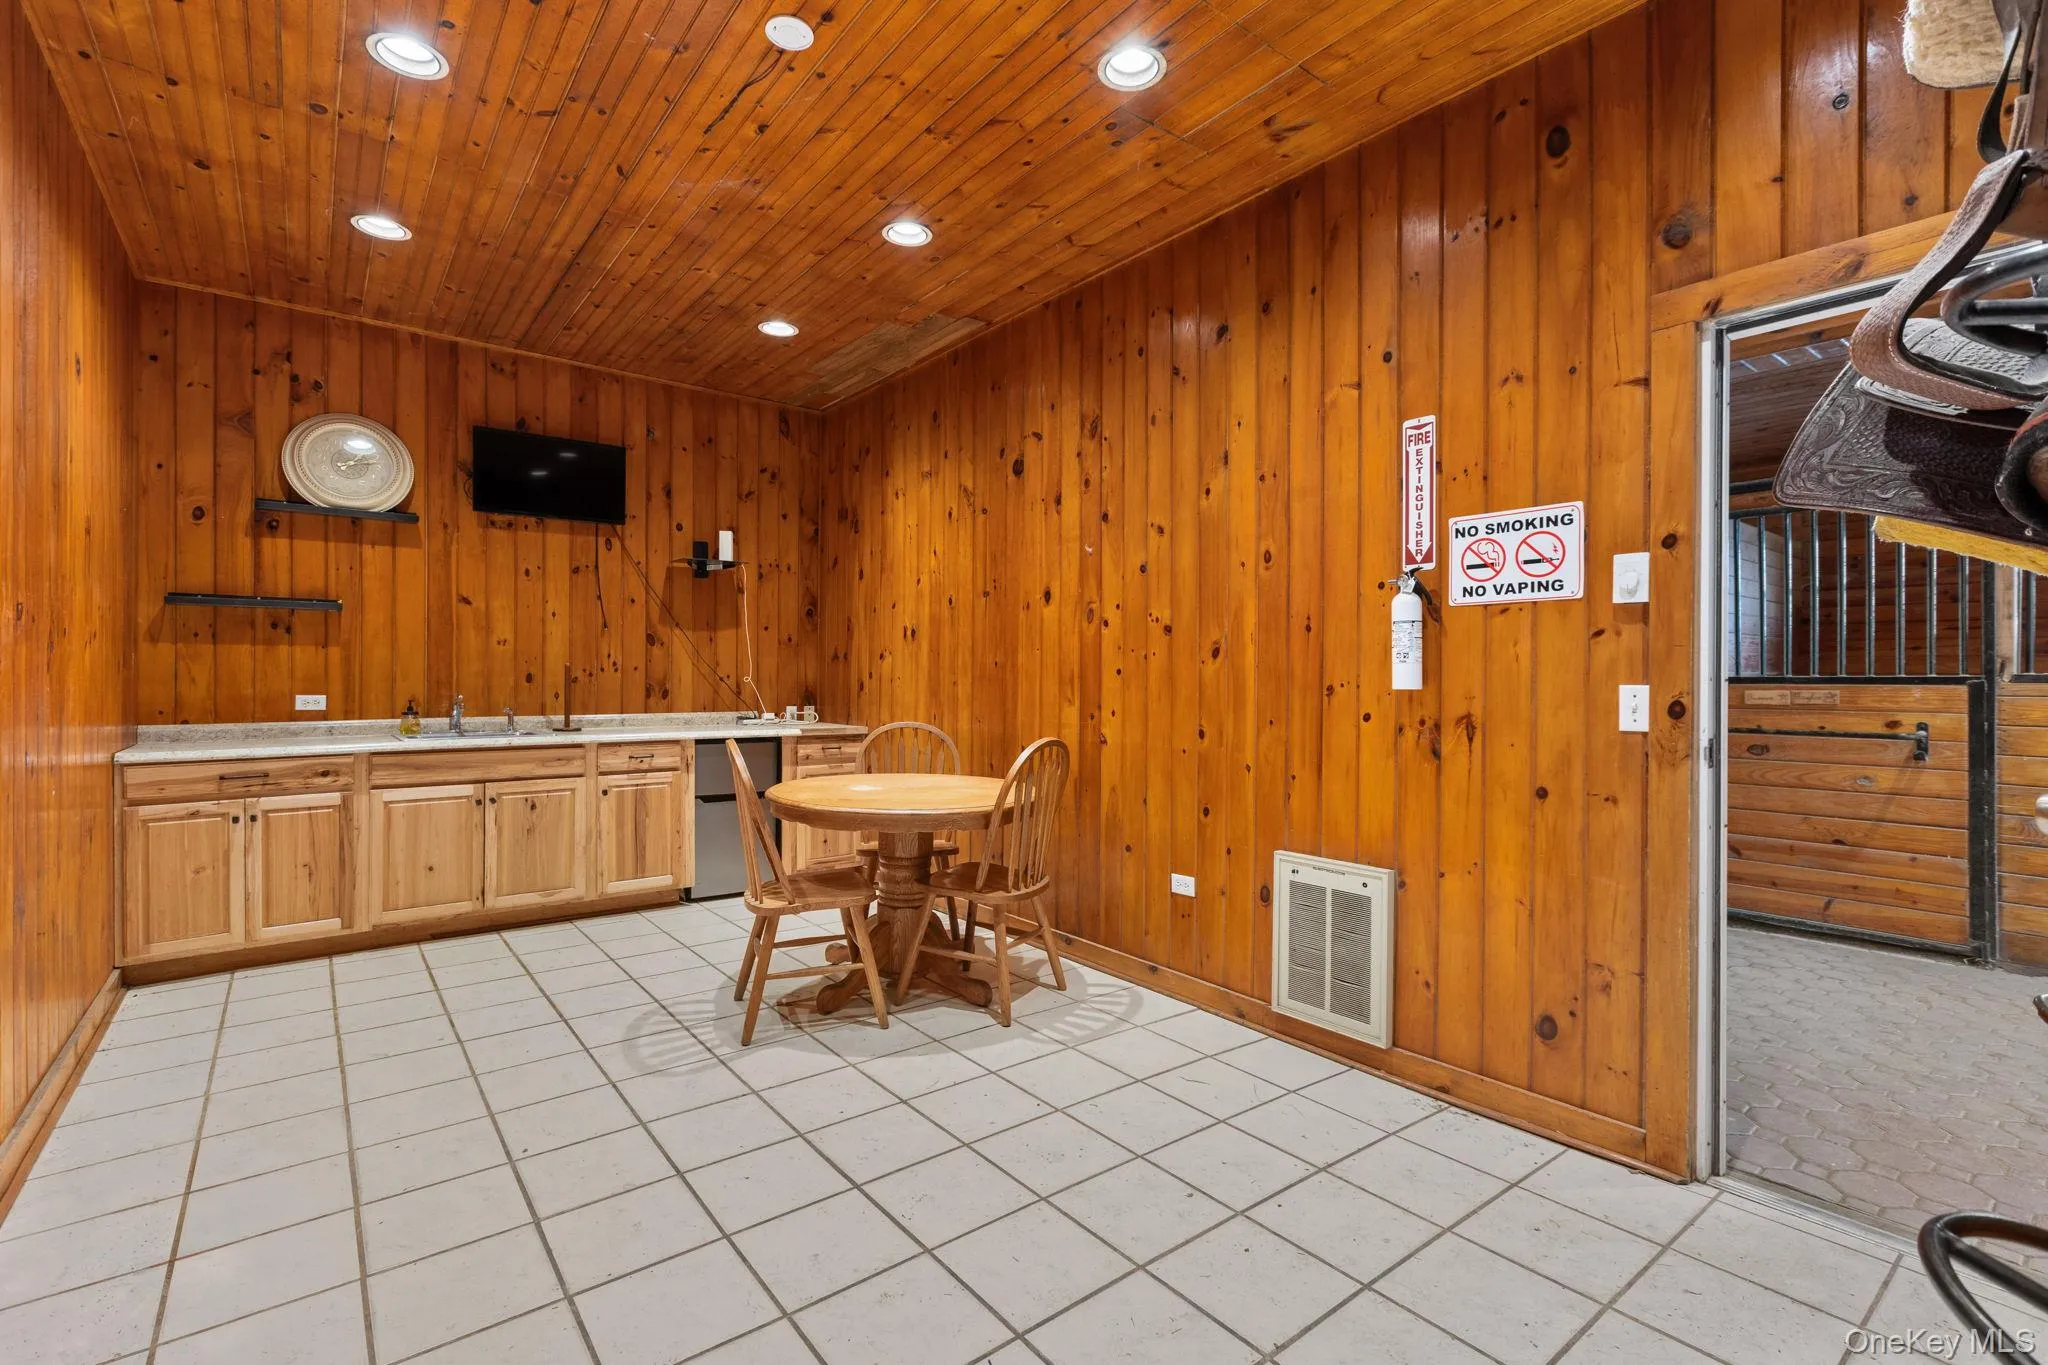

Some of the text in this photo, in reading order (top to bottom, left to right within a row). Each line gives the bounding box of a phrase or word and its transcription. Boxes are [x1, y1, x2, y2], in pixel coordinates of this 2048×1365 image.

[1407, 430, 1431, 447] FIRE
[1415, 448, 1424, 557] EXTINGUISHER
[1454, 513, 1574, 539] NO SMOKING
[1462, 579, 1564, 598] NO VAPING
